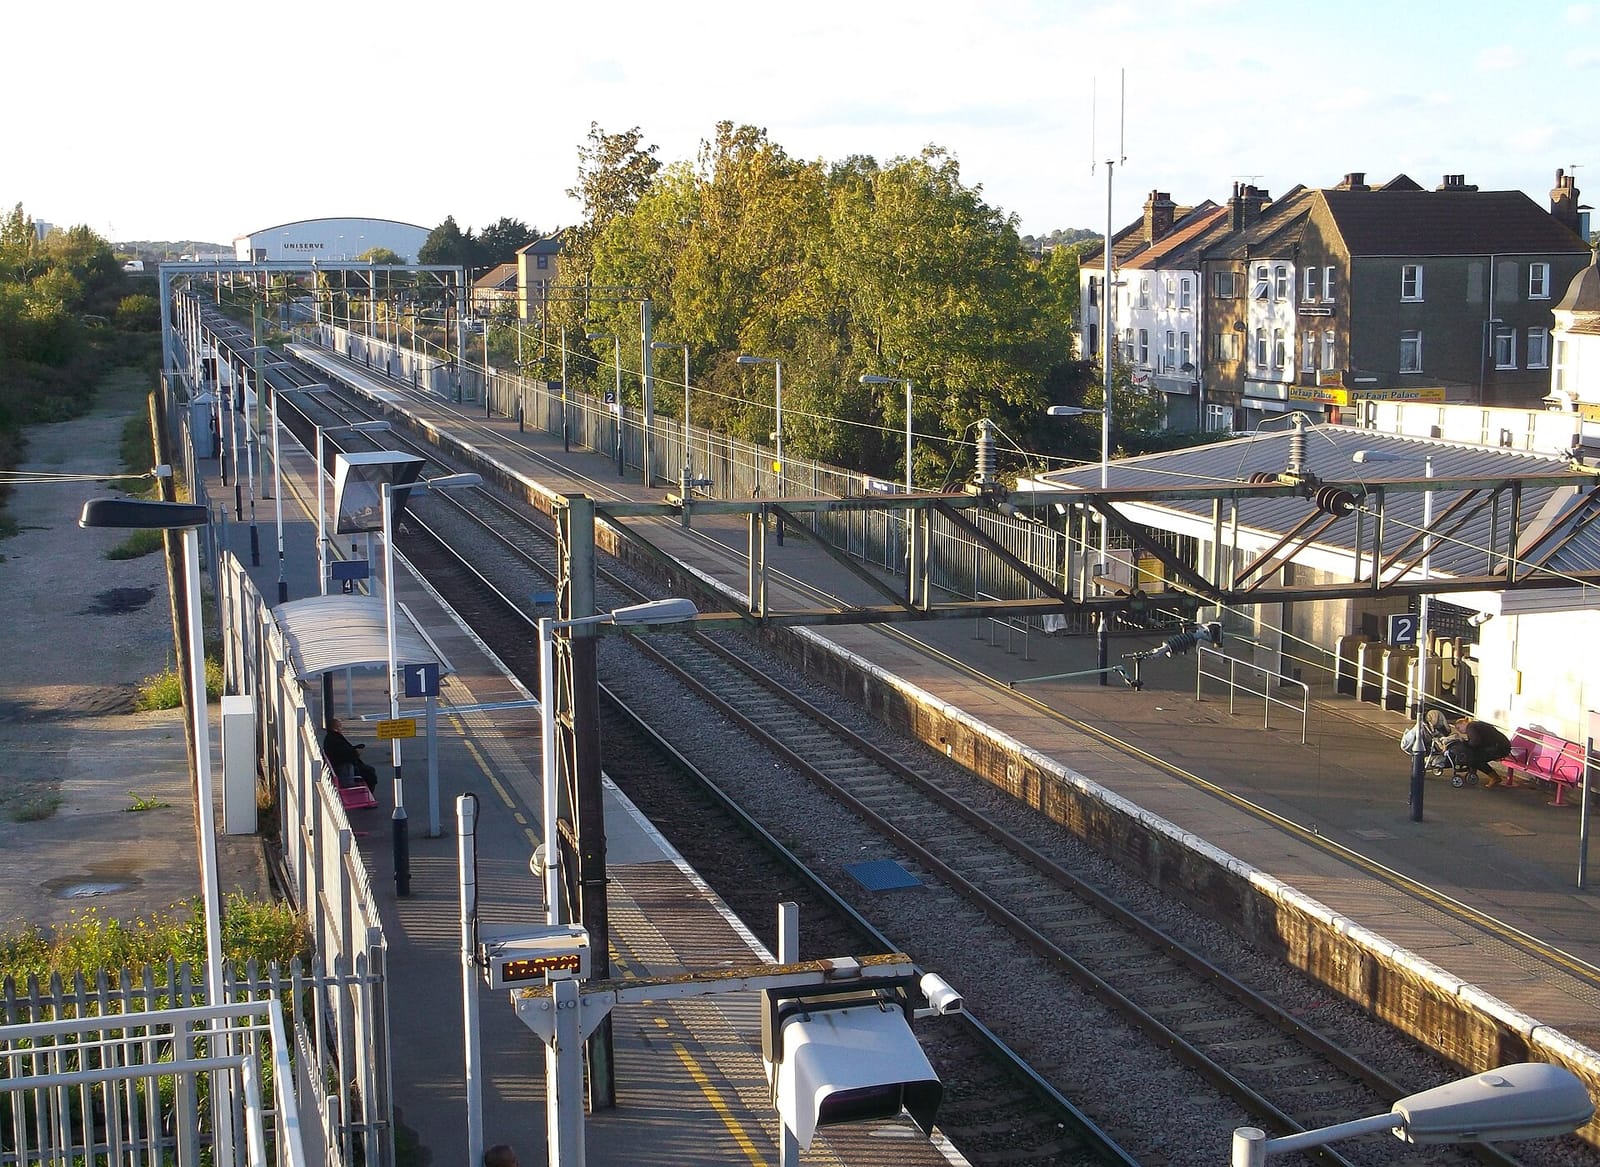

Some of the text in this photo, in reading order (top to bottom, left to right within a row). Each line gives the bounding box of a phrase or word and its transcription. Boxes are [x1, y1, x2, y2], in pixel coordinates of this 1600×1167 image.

[606, 393, 615, 402] 2
[1391, 391, 1419, 399] Palace
[1396, 618, 1411, 641] 2
[415, 667, 426, 693] 1
